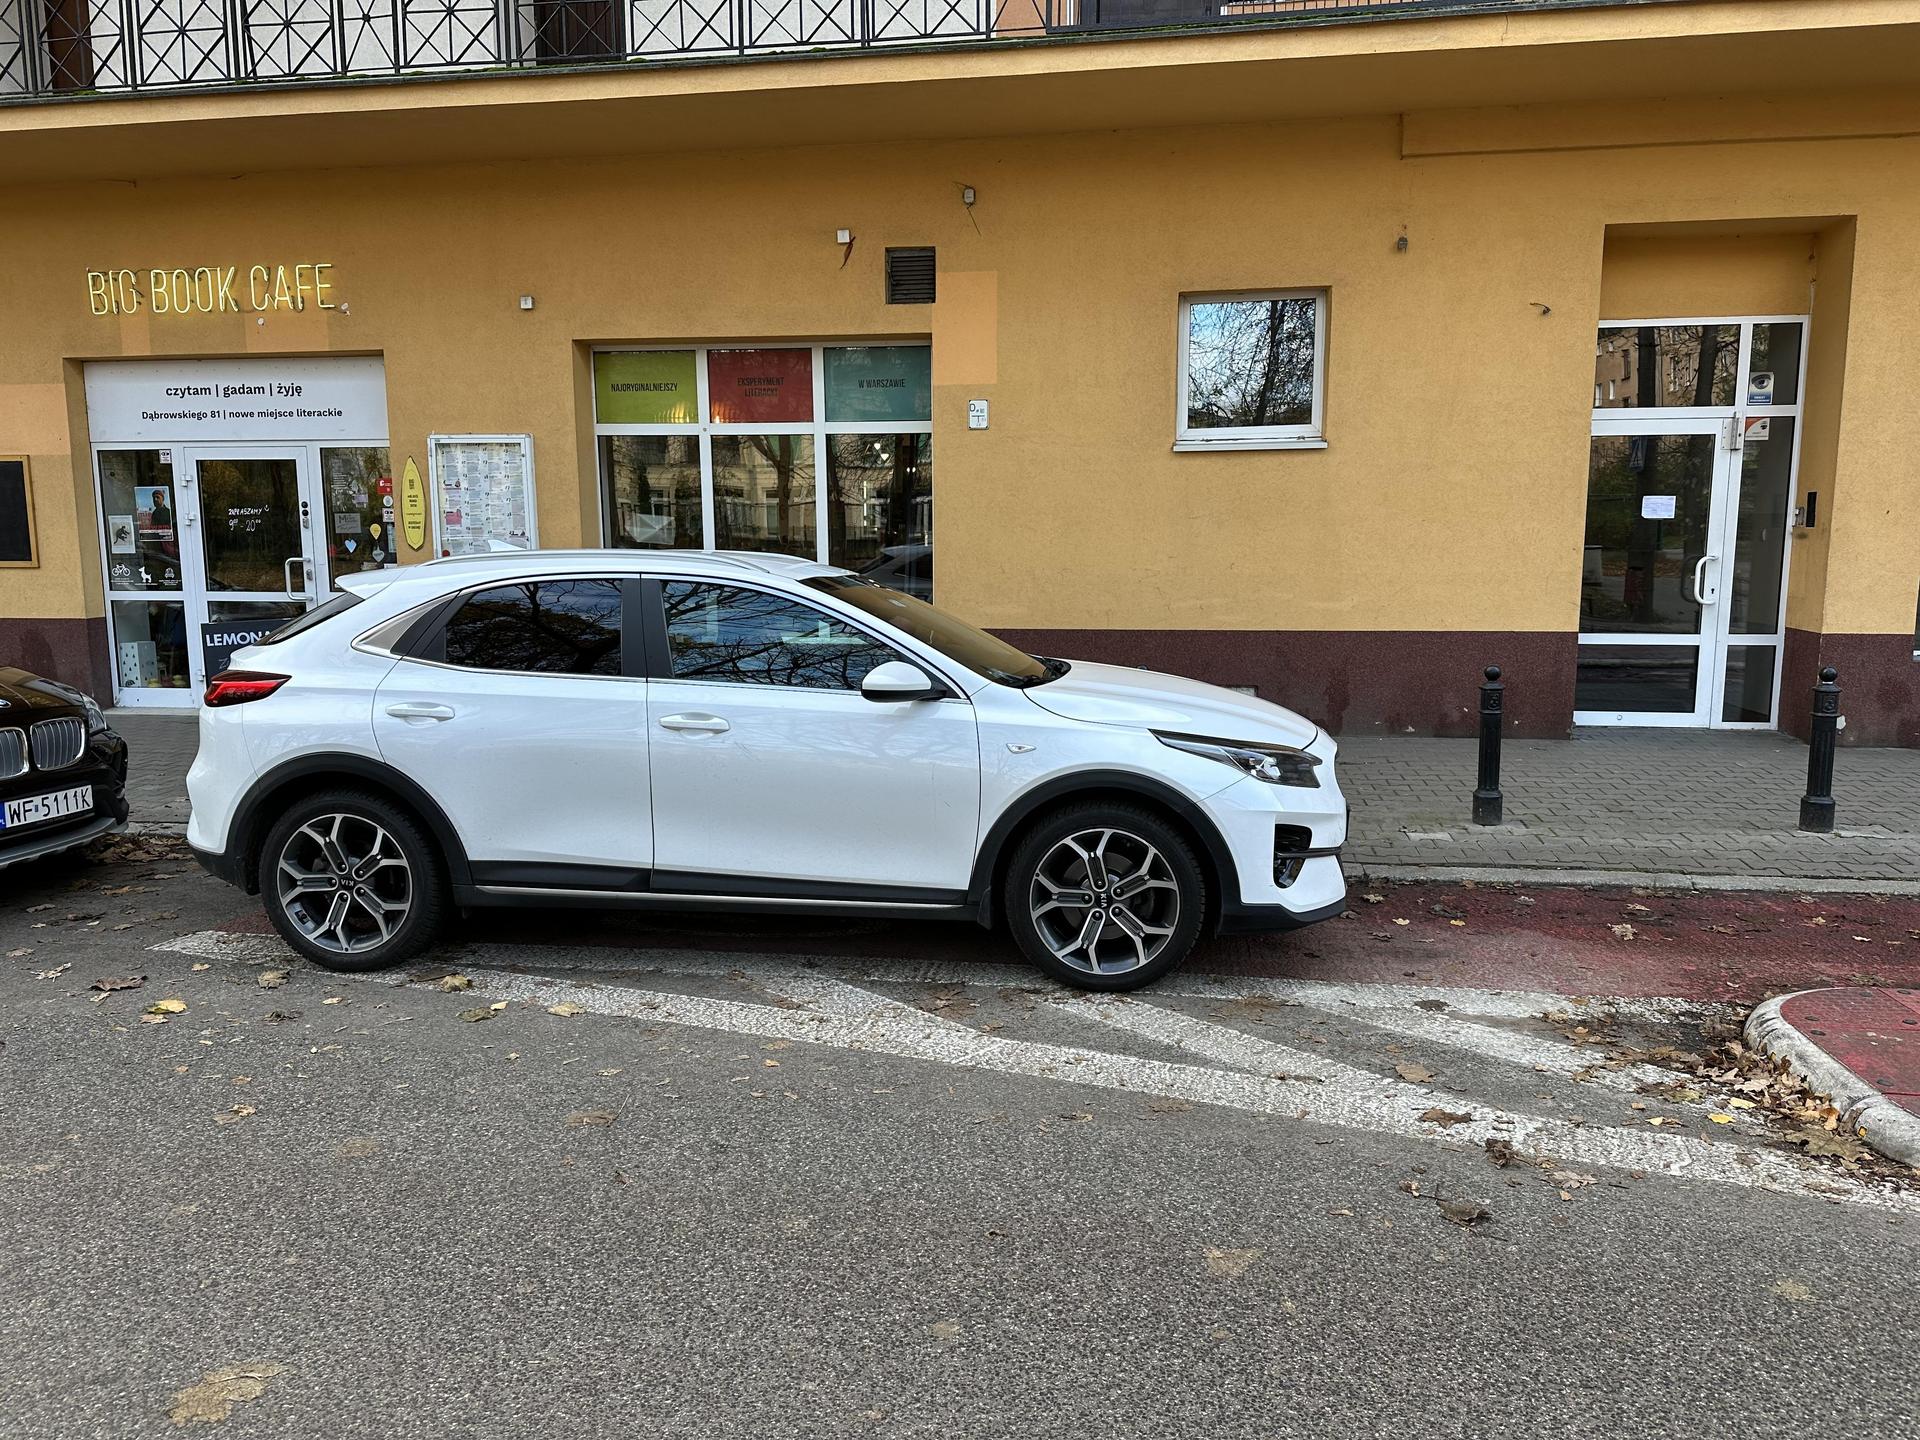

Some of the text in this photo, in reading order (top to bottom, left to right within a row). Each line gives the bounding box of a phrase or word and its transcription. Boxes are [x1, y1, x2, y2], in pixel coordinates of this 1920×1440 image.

[88, 263, 335, 314] BIG BOOK CAFE
[165, 385, 212, 399] czytam
[223, 383, 265, 398] gadam
[276, 382, 303, 397] żyję
[610, 382, 679, 393] NAJORYGINALNIEJSZY
[141, 410, 208, 421] Dąbrowskiego
[210, 410, 221, 419] 81
[229, 410, 255, 418] nowe
[257, 408, 294, 420] miejsce
[296, 407, 343, 418] literackie
[8, 799, 34, 825] WF
[41, 787, 91, 818] 5111K
